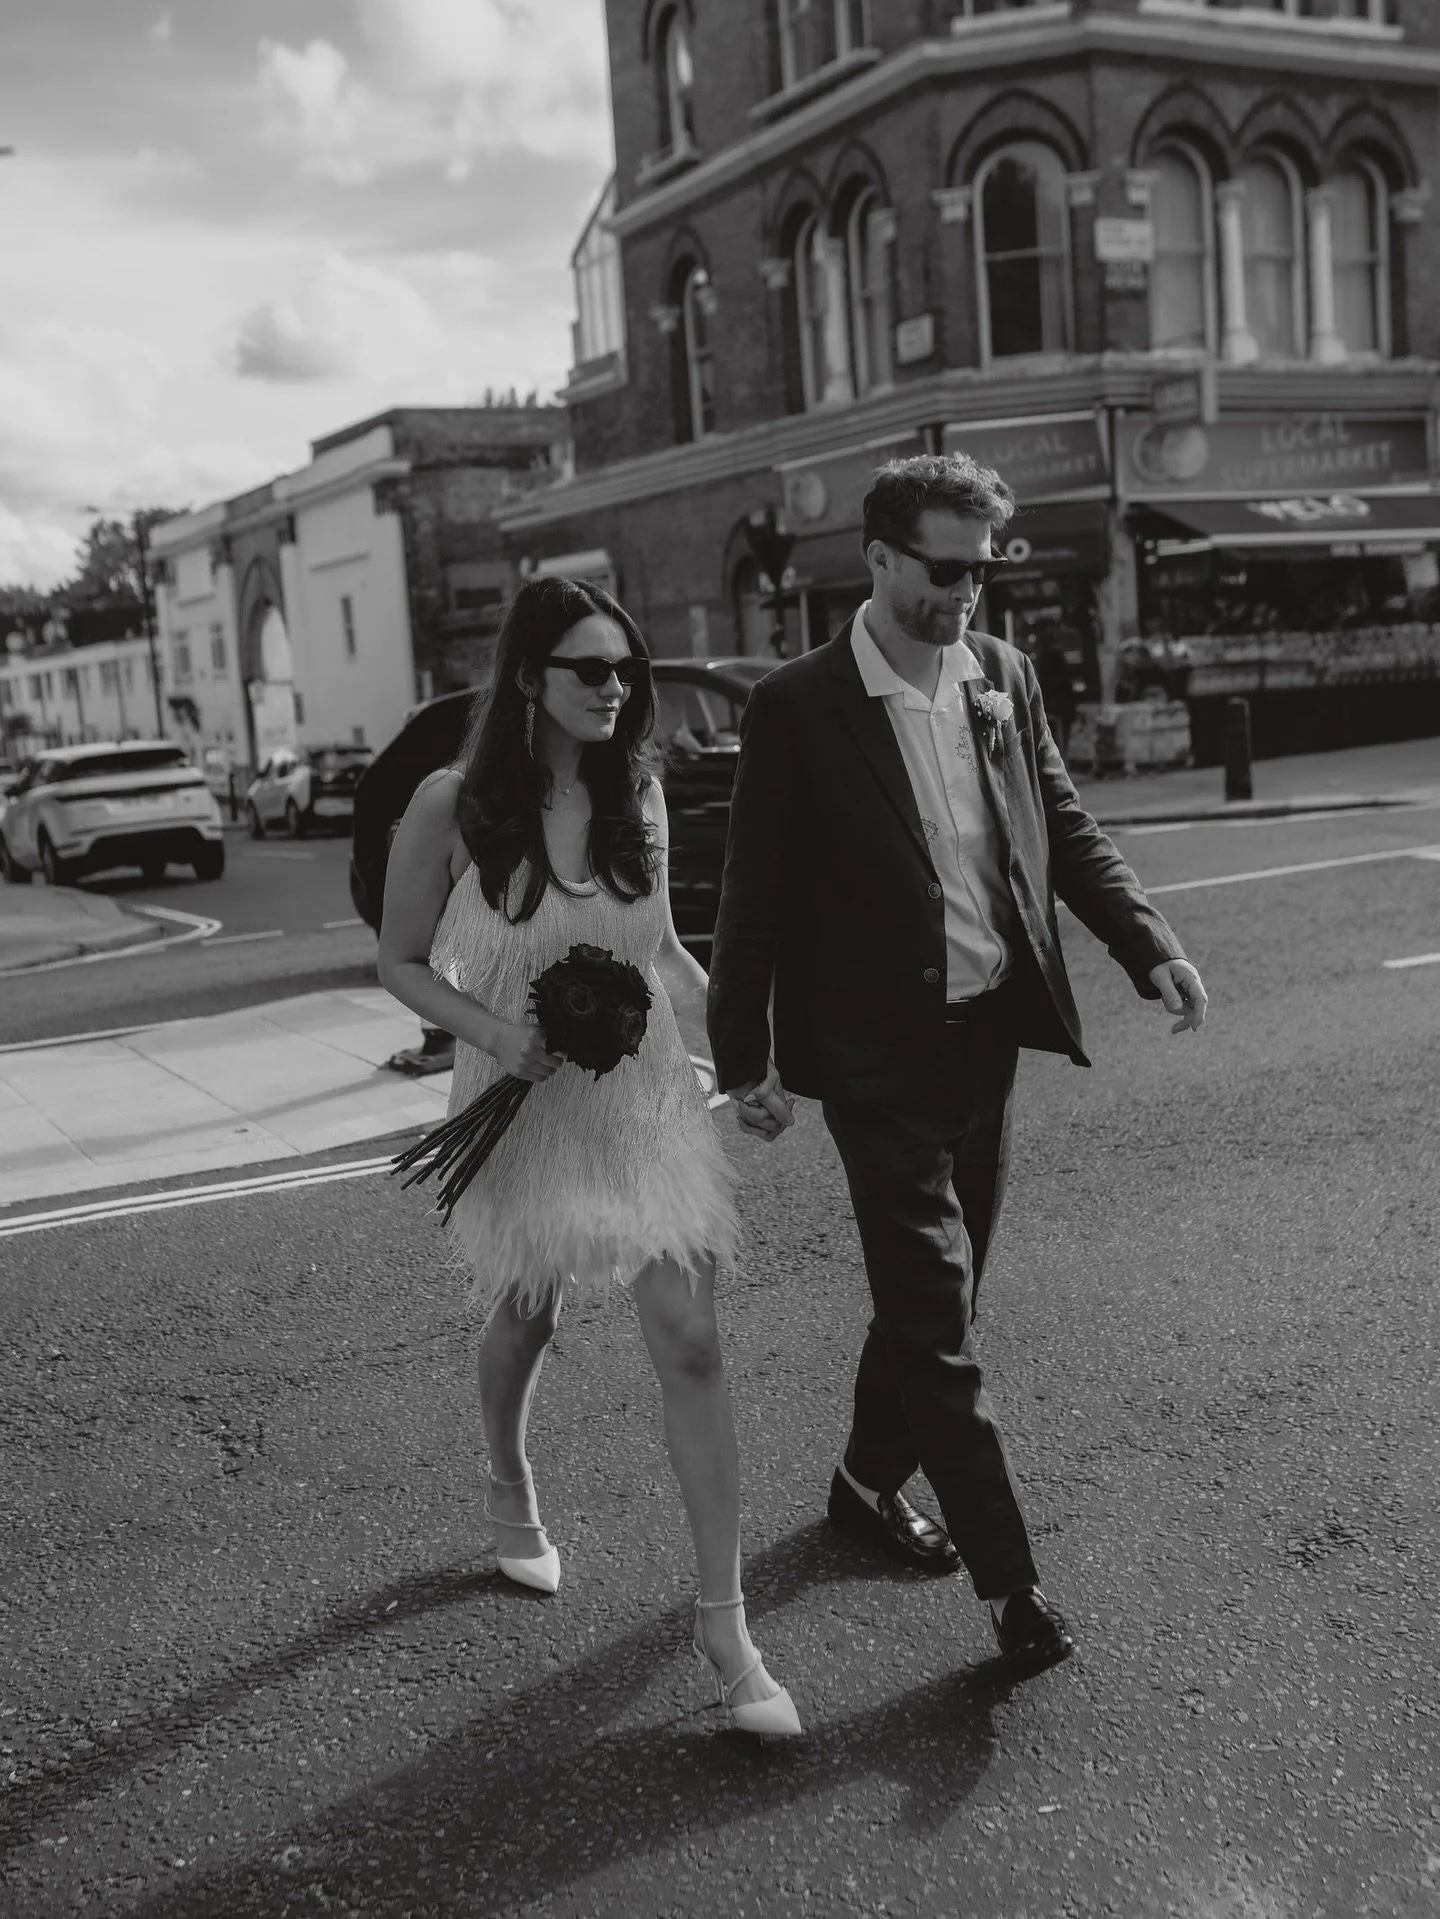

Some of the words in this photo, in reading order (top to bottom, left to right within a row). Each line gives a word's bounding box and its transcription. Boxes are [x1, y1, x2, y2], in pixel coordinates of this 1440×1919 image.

[978, 431, 1070, 465] LOCAL
[1261, 413, 1352, 454] LOCAL
[1219, 440, 1394, 490] SUPERMARKET
